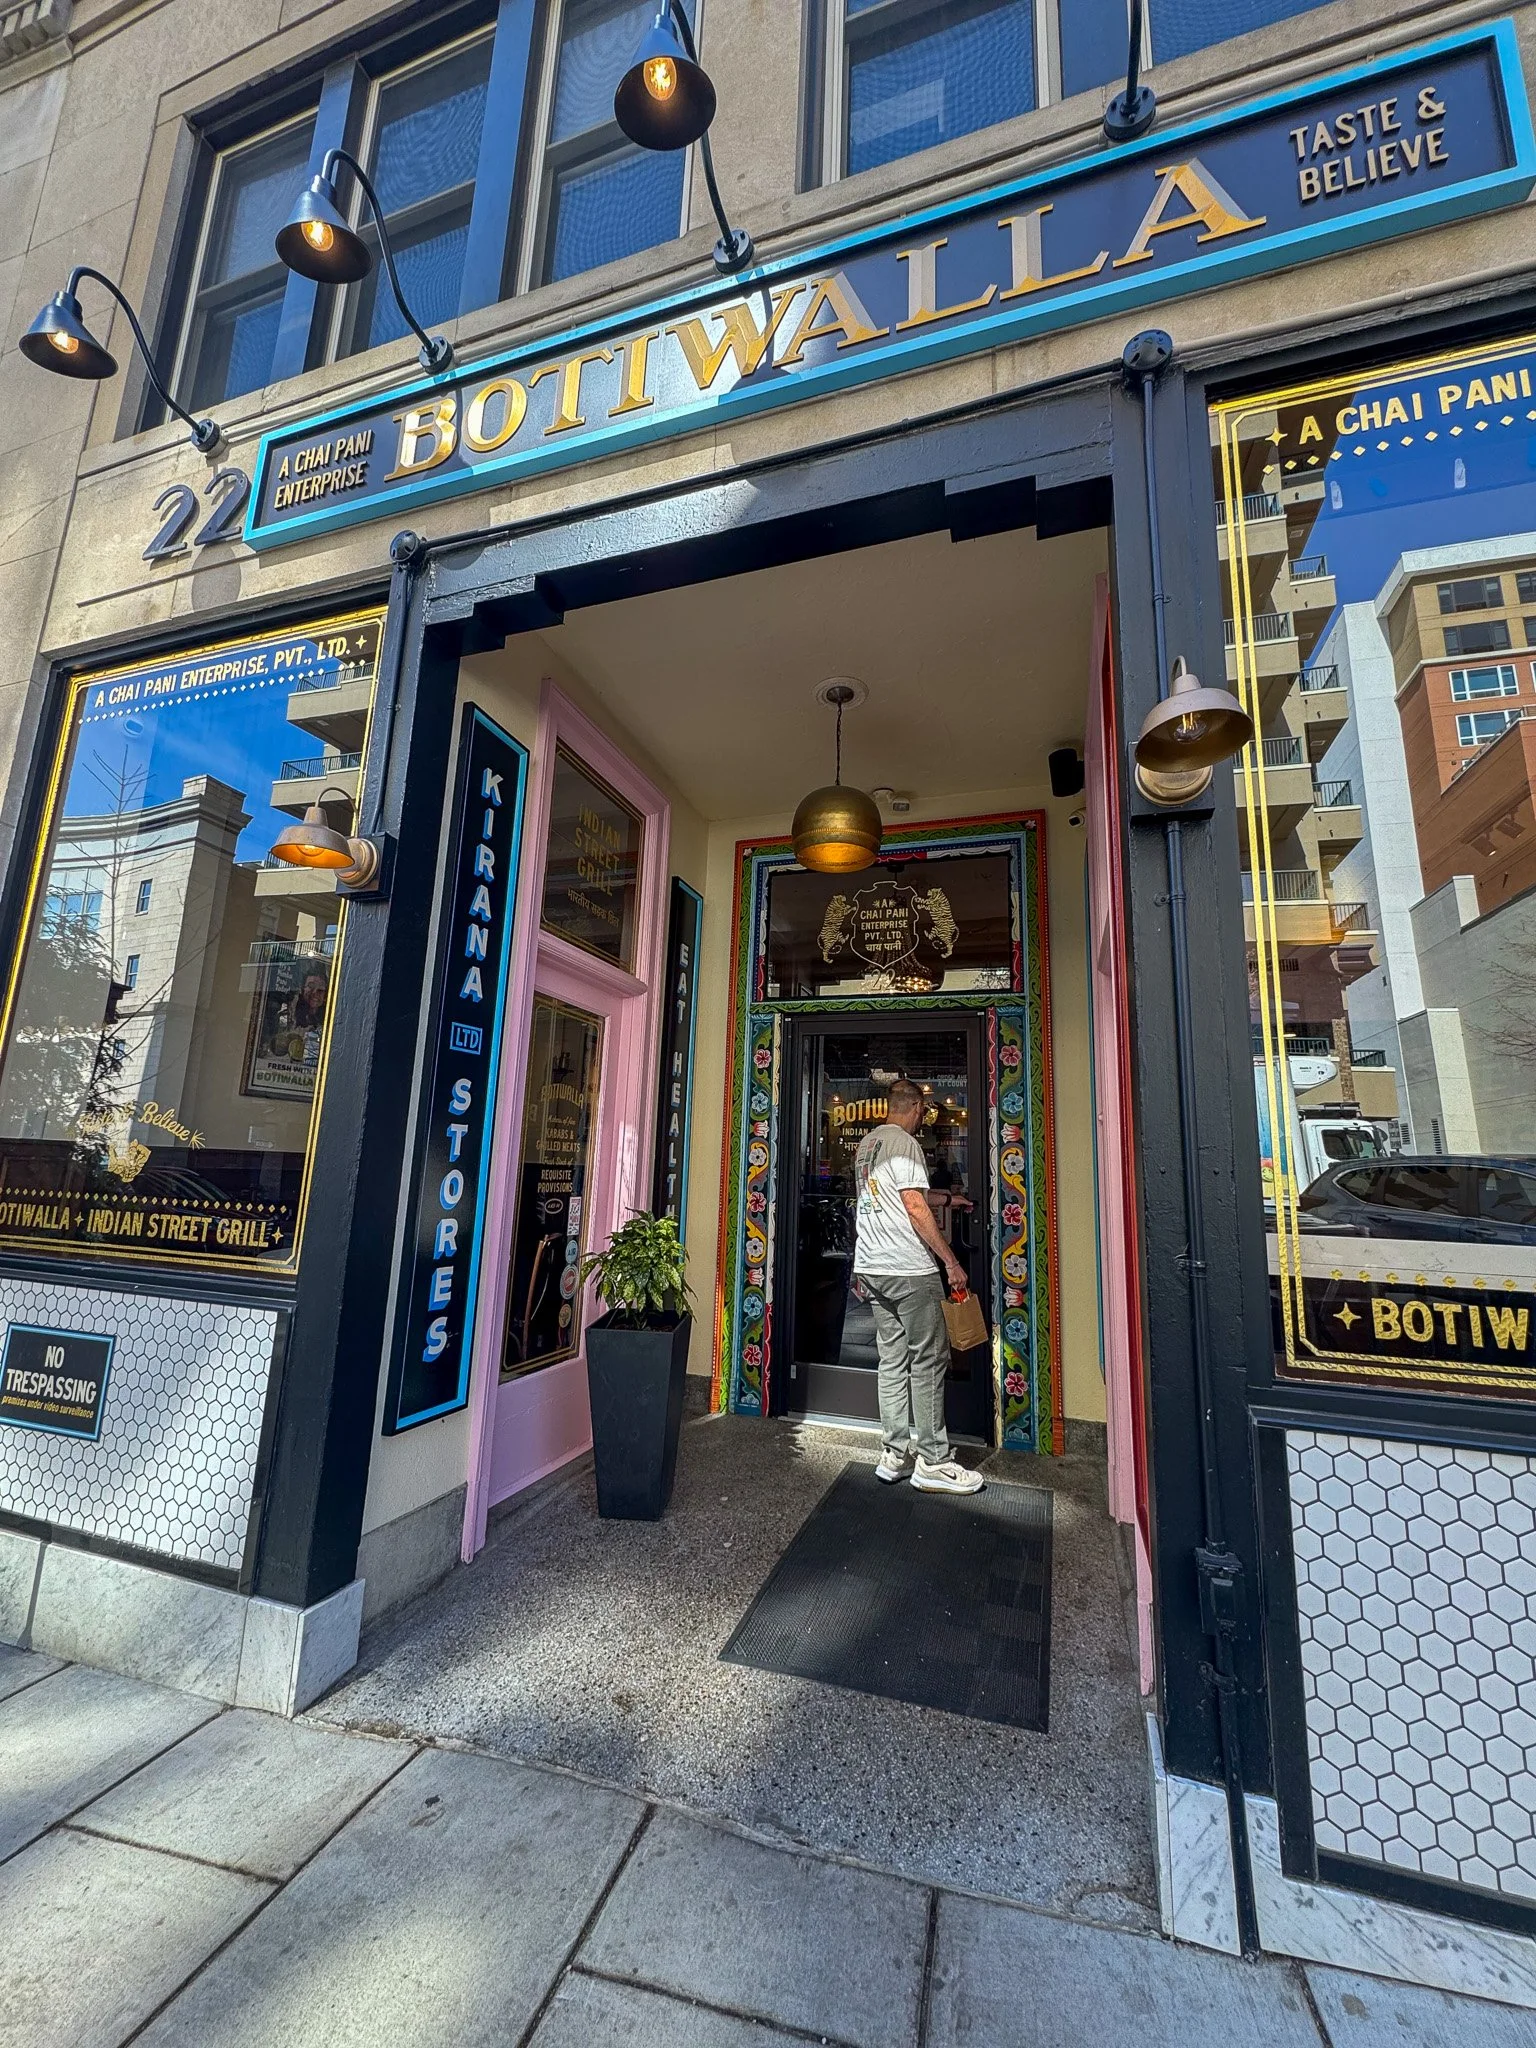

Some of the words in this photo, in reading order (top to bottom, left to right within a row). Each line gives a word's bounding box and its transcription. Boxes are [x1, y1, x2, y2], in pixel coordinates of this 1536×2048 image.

[1289, 98, 1401, 158] TASTE
[1418, 86, 1447, 120] &
[1299, 127, 1449, 200] BELIEVE
[383, 158, 1268, 482] BOTIWALLA
[1299, 415, 1324, 444] A
[1335, 392, 1423, 436] CHAI
[1438, 368, 1532, 415] PANI
[278, 456, 289, 480] A
[294, 442, 331, 473] CHAI
[335, 429, 374, 461] PANI
[274, 461, 368, 509] ENTERPRISE
[142, 467, 250, 561] 22
[94, 690, 105, 708] A
[108, 683, 141, 705] CHAI
[144, 674, 177, 698] PANI
[180, 654, 269, 689] ENTERPRISE,
[273, 646, 313, 671] PVT.,
[317, 636, 351, 661] LTD.
[579, 803, 620, 852] INDIAN
[575, 827, 620, 874] STREET
[459, 767, 504, 1007] KIRANA
[577, 856, 613, 897] GRILL
[860, 909, 883, 920] CHAI
[886, 907, 909, 918] PANI
[881, 898, 888, 908] A
[861, 920, 908, 931] ENTERPRISE
[886, 930, 904, 940] LTD.
[865, 942, 882, 952] चाय
[884, 940, 902, 952] पानी
[675, 943, 690, 1024] EAT
[455, 1031, 479, 1049] LTD
[268, 1062, 292, 1072] FRESH
[138, 1101, 191, 1141] Believe
[833, 1098, 888, 1127] BOTIW
[561, 1141, 581, 1153] MEATS
[537, 1182, 573, 1193] PROVISIONS
[541, 1169, 573, 1181] REQUISITE
[87, 1209, 144, 1237] INDIAN
[147, 1213, 212, 1243] STREET
[215, 1218, 269, 1248] GRILL
[423, 1078, 472, 1363] STORES
[1371, 1297, 1528, 1351] BOTIW
[44, 1345, 65, 1369] NO
[6, 1368, 97, 1404] TRESPASSING
[1, 1395, 27, 1406] premises
[27, 1399, 43, 1410] under
[43, 1401, 60, 1413] video
[59, 1405, 95, 1419] surveillance
